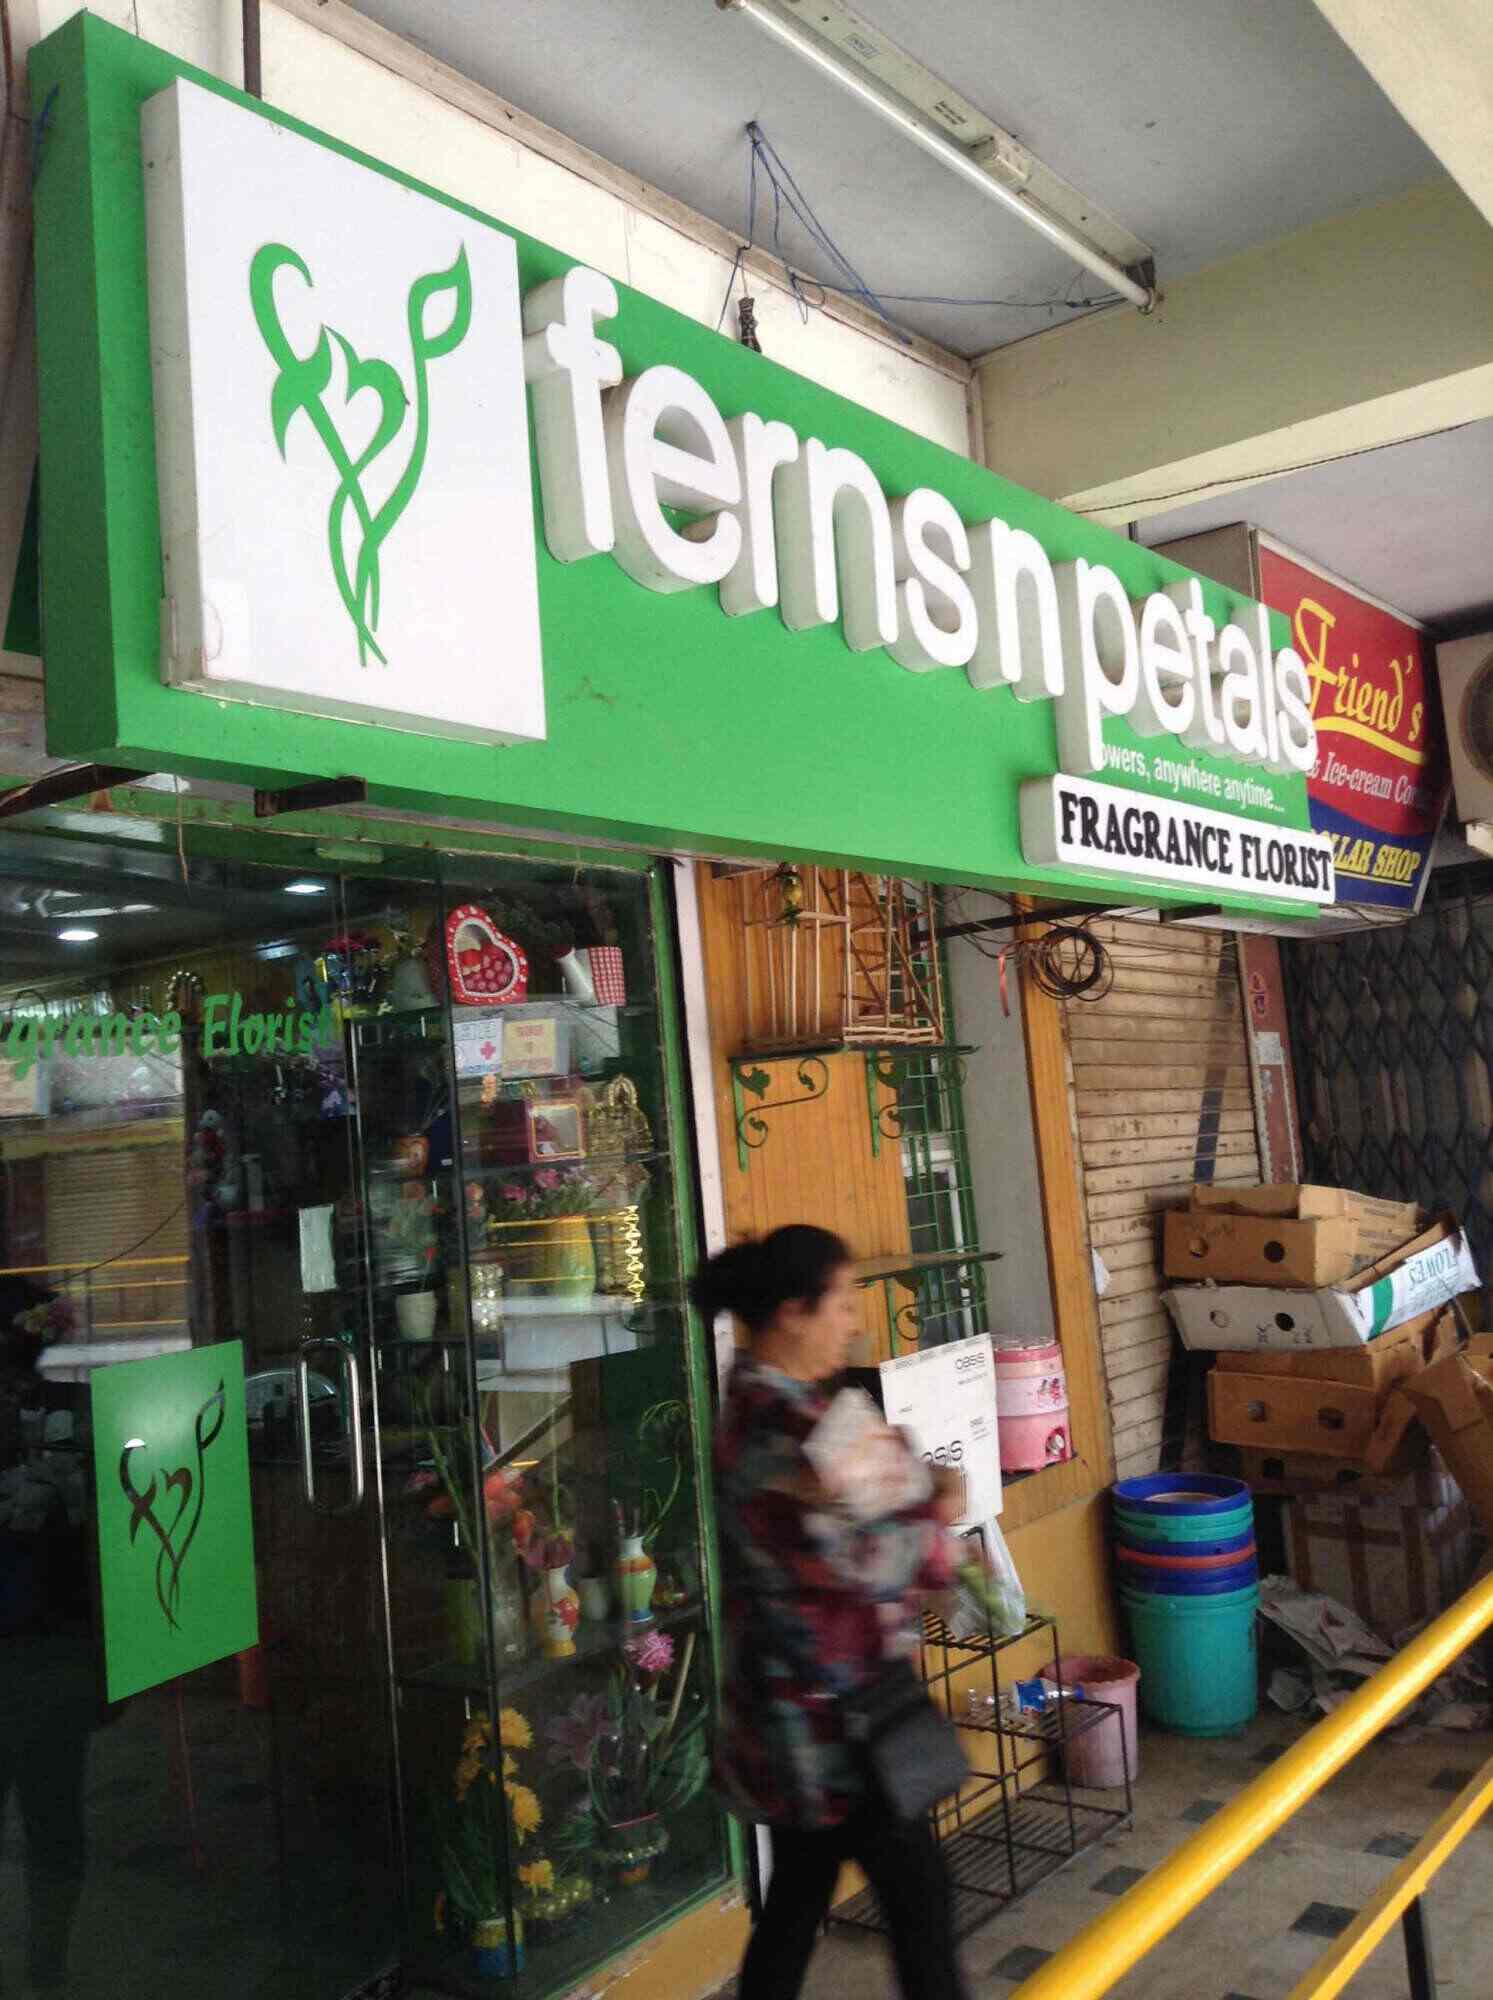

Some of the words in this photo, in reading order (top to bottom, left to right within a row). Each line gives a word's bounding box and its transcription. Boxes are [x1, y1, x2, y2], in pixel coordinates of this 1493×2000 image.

[546, 266, 978, 667] ferns
[1075, 557, 1319, 772] petals
[1295, 598, 1424, 742] Friend's
[1102, 742, 1151, 784] owers,
[1154, 754, 1222, 797] anywhere
[1321, 751, 1393, 800] Ice-cream
[1059, 790, 1233, 875] FRAGRANCE
[1240, 833, 1332, 892] FLORIST
[1372, 844, 1422, 881] SHOP
[0, 1012, 182, 1081] grance
